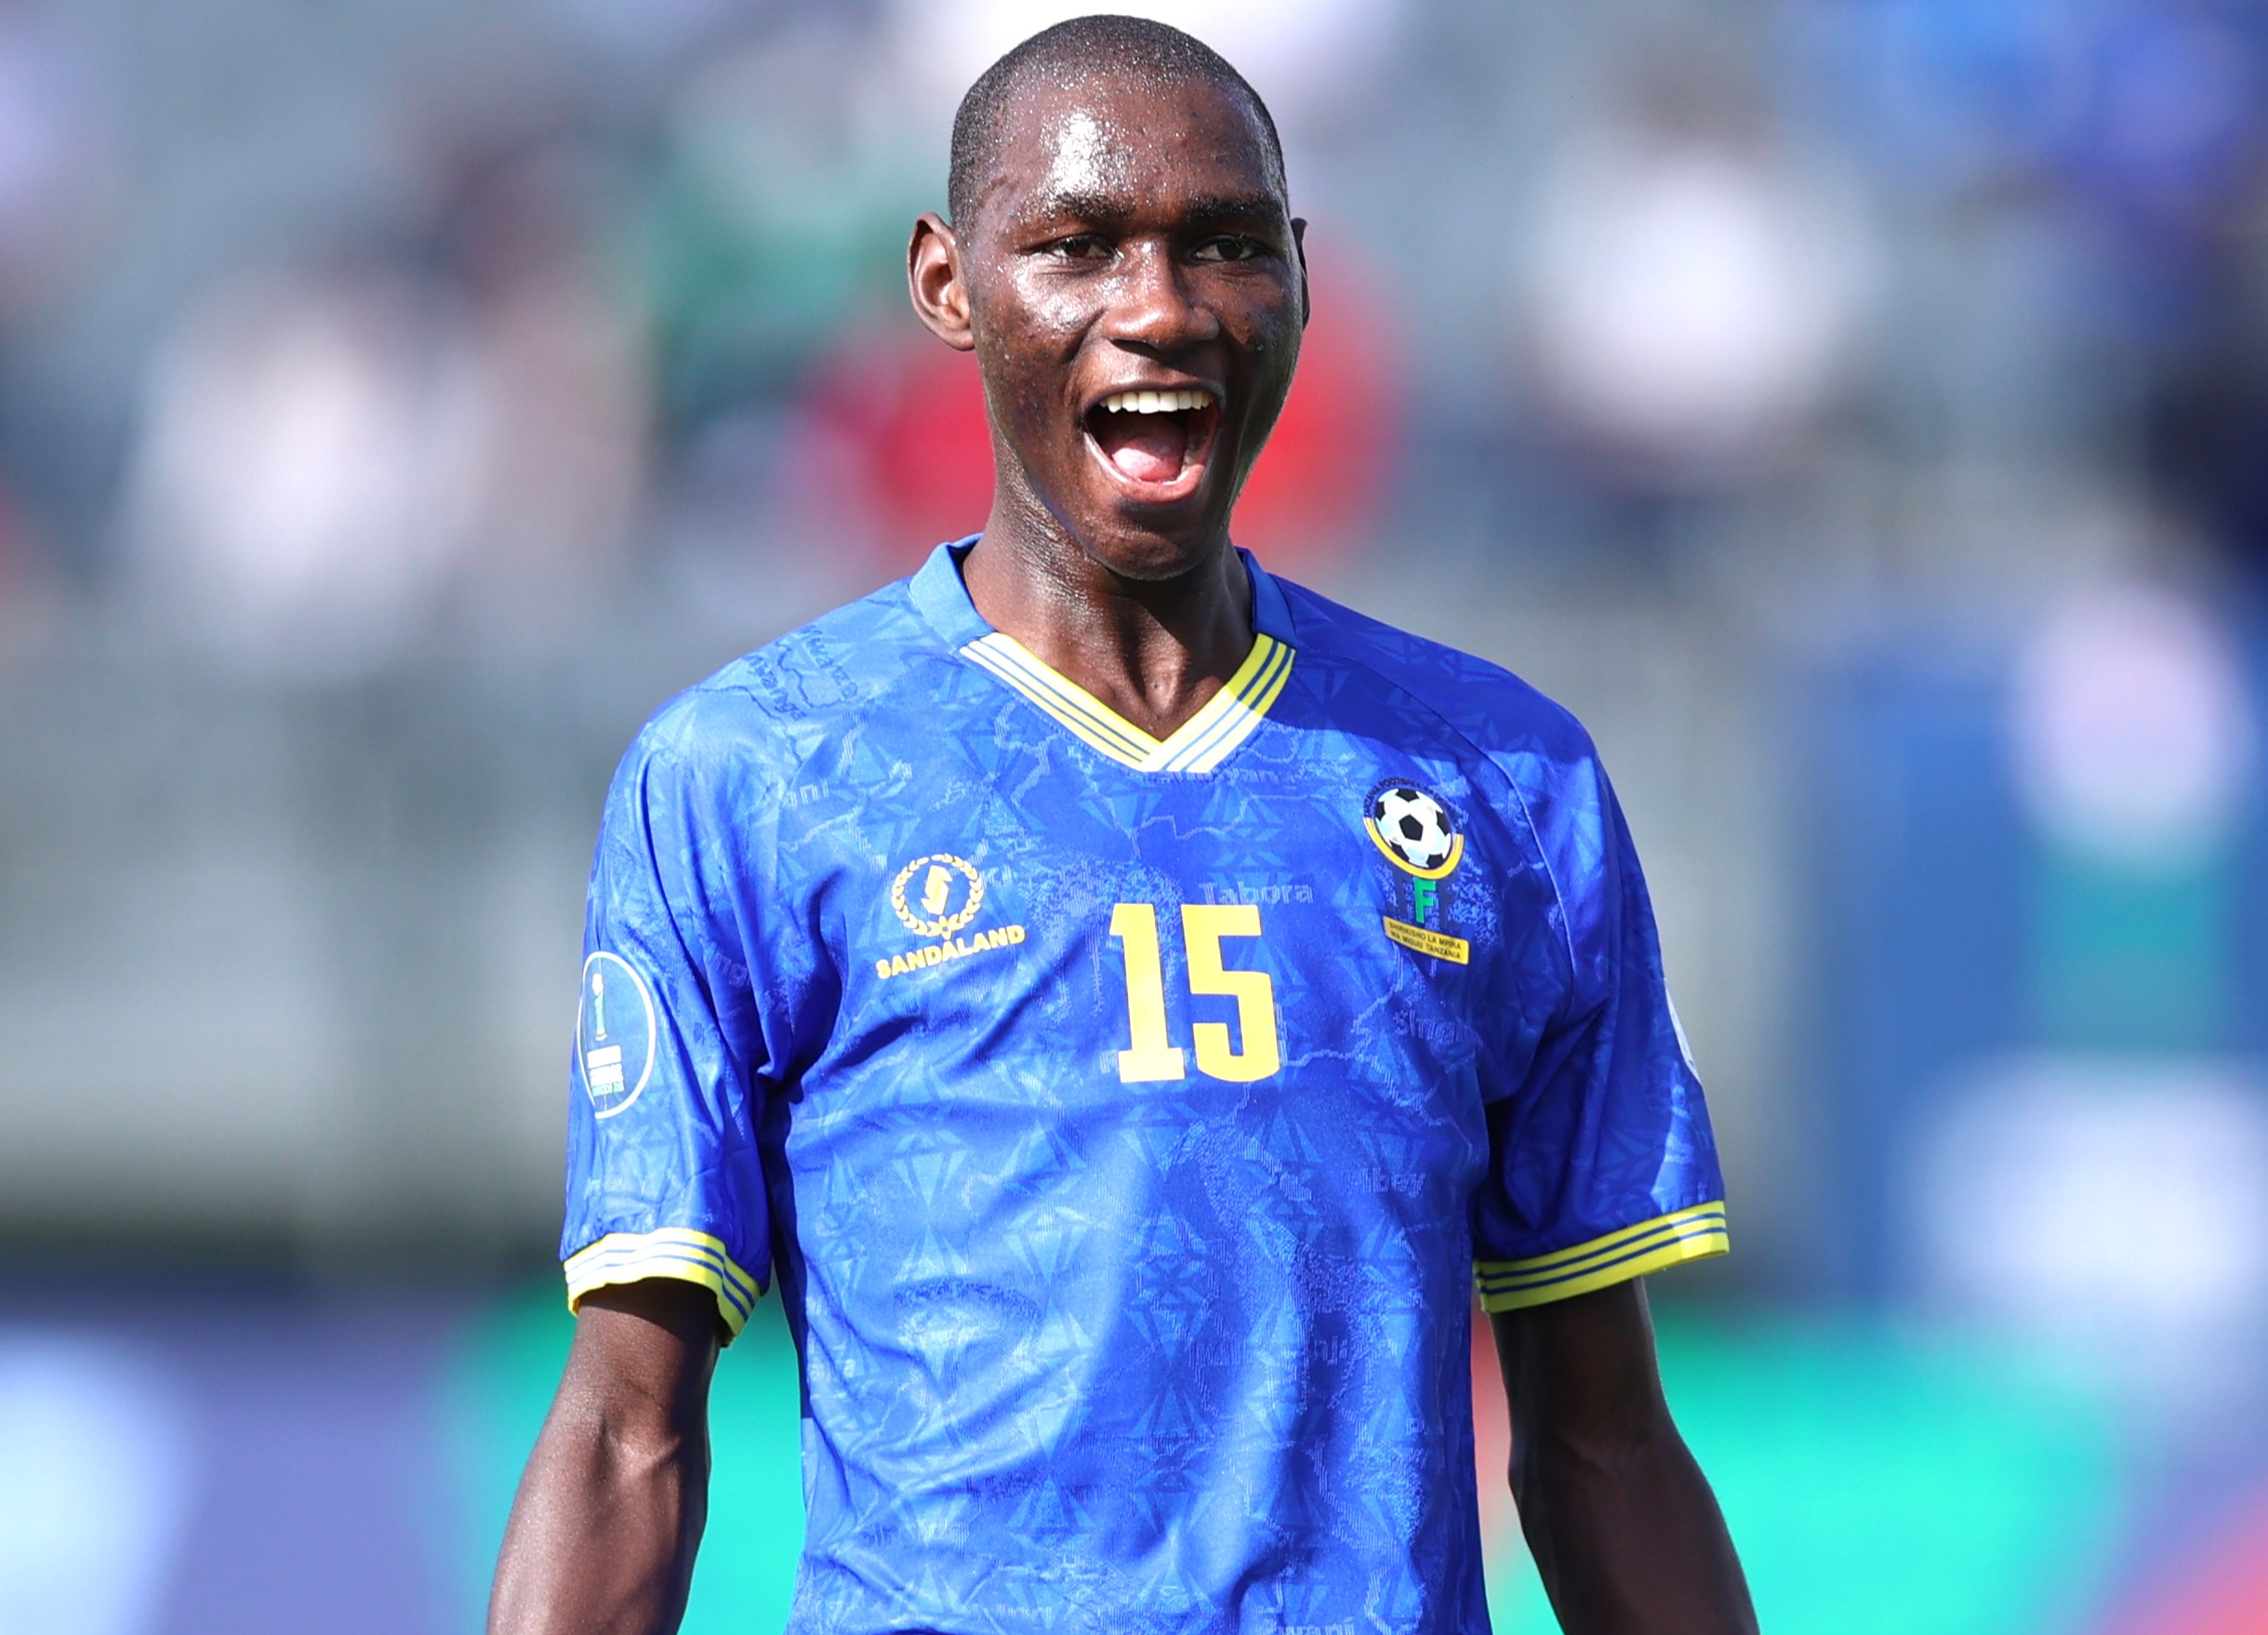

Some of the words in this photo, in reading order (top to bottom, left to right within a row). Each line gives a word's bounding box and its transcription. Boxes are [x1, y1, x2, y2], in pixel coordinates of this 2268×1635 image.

[1200, 880, 1314, 906] Tabora
[876, 924, 1026, 980] SANDALAND
[1402, 934, 1424, 950] MIGUU
[1426, 943, 1462, 960] TANZANIA
[1427, 933, 1438, 945] LA
[1108, 902, 1281, 1083] 15
